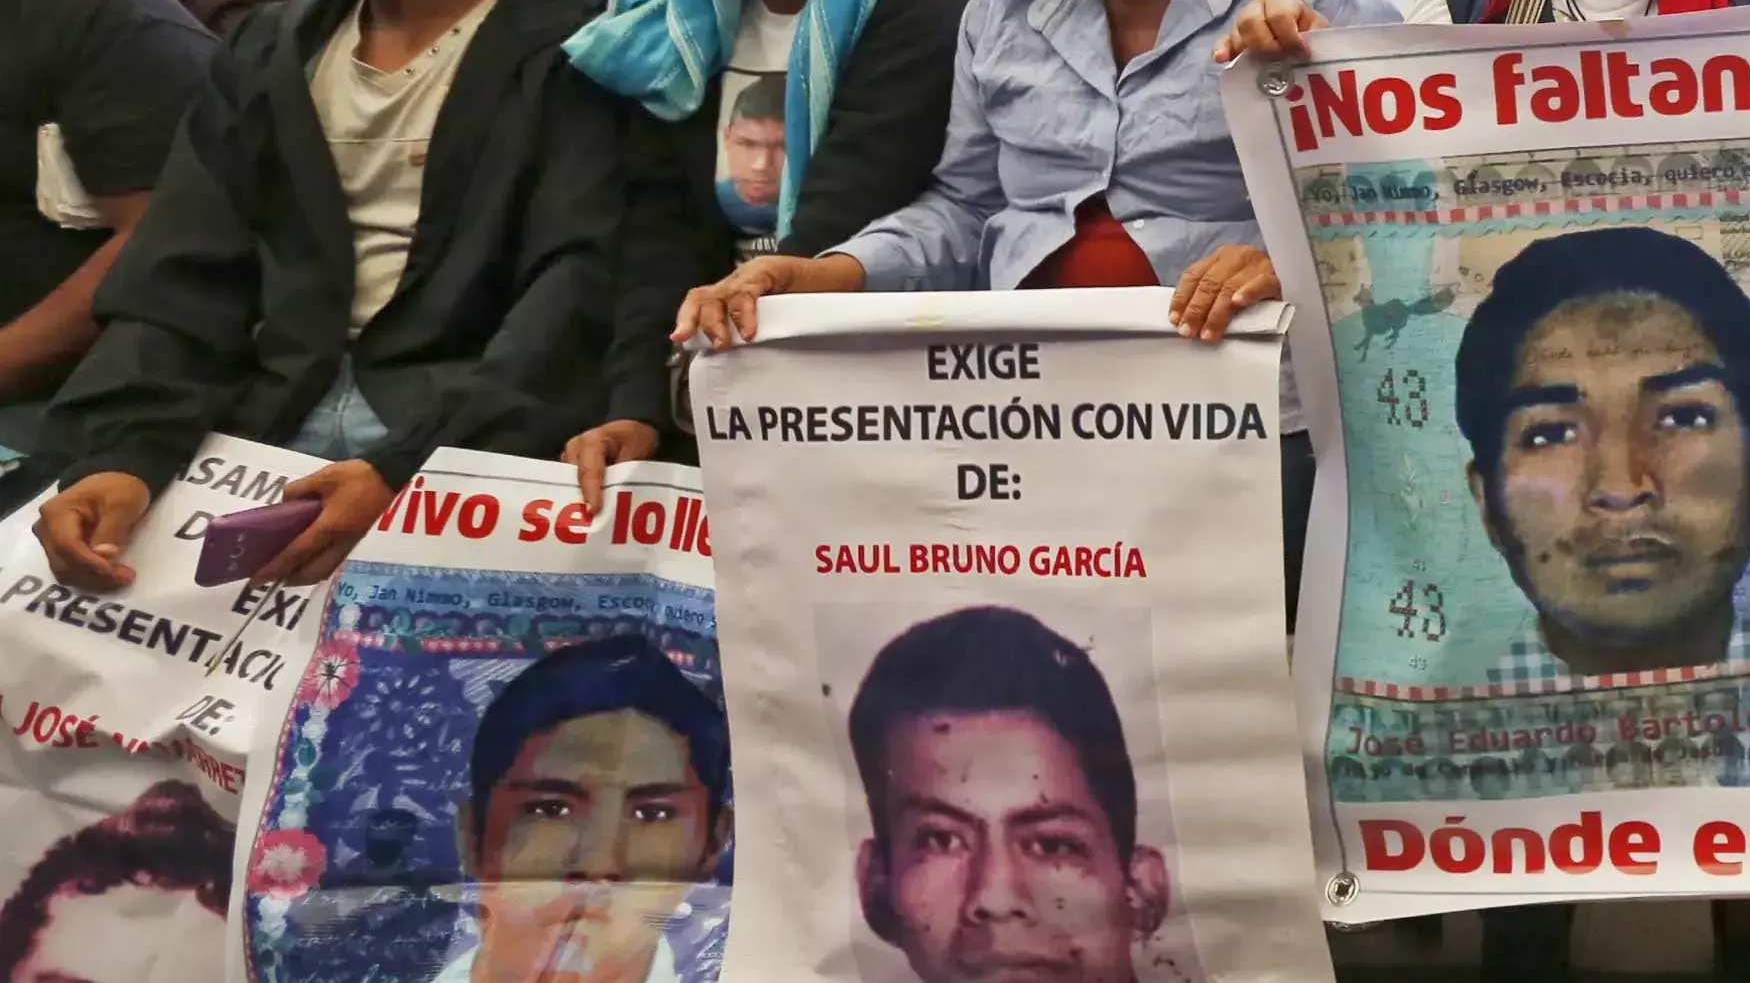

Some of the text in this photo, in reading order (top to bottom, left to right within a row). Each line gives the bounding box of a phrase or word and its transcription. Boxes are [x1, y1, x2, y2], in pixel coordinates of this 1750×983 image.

[1286, 68, 1464, 153] ¡Nos
[927, 342, 1041, 381] EXIGE
[706, 396, 1268, 443] LA PRESENTACIÓN CON VIDA
[1376, 367, 1429, 429] 43
[957, 463, 1023, 502] DE:
[517, 498, 593, 545] se
[610, 491, 667, 545] lo
[815, 541, 1147, 579] SAUL BRUNO GARCÍA
[231, 578, 311, 632] EXI
[368, 583, 398, 601] Jan
[1389, 579, 1447, 642] 43
[13, 701, 102, 750] JOSÉ
[1451, 721, 1597, 754] Eduardo
[1358, 811, 1662, 876] Dónde
